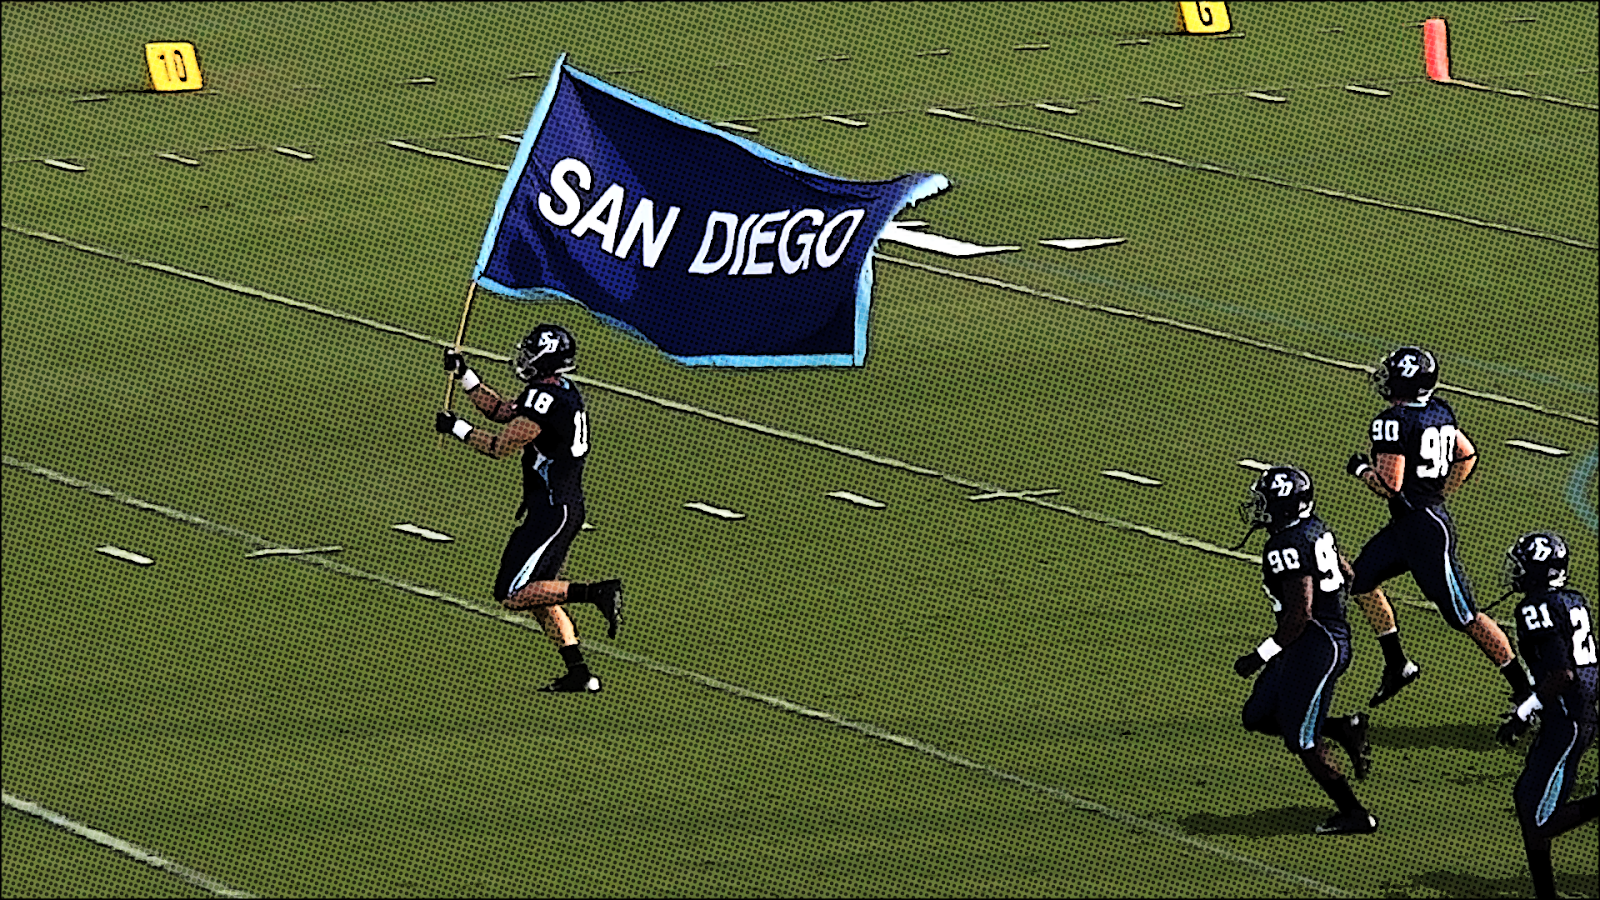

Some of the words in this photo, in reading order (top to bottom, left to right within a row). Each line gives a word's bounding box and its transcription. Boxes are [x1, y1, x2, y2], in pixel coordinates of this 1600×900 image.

[157, 49, 188, 83] 10
[538, 156, 681, 269] SAN
[688, 207, 866, 276] DIEGO
[524, 388, 555, 415] 18
[1372, 418, 1400, 442] 90
[1416, 424, 1456, 479] 90
[1267, 547, 1301, 574] 90
[1314, 531, 1345, 593] 9
[1521, 602, 1555, 631] 21
